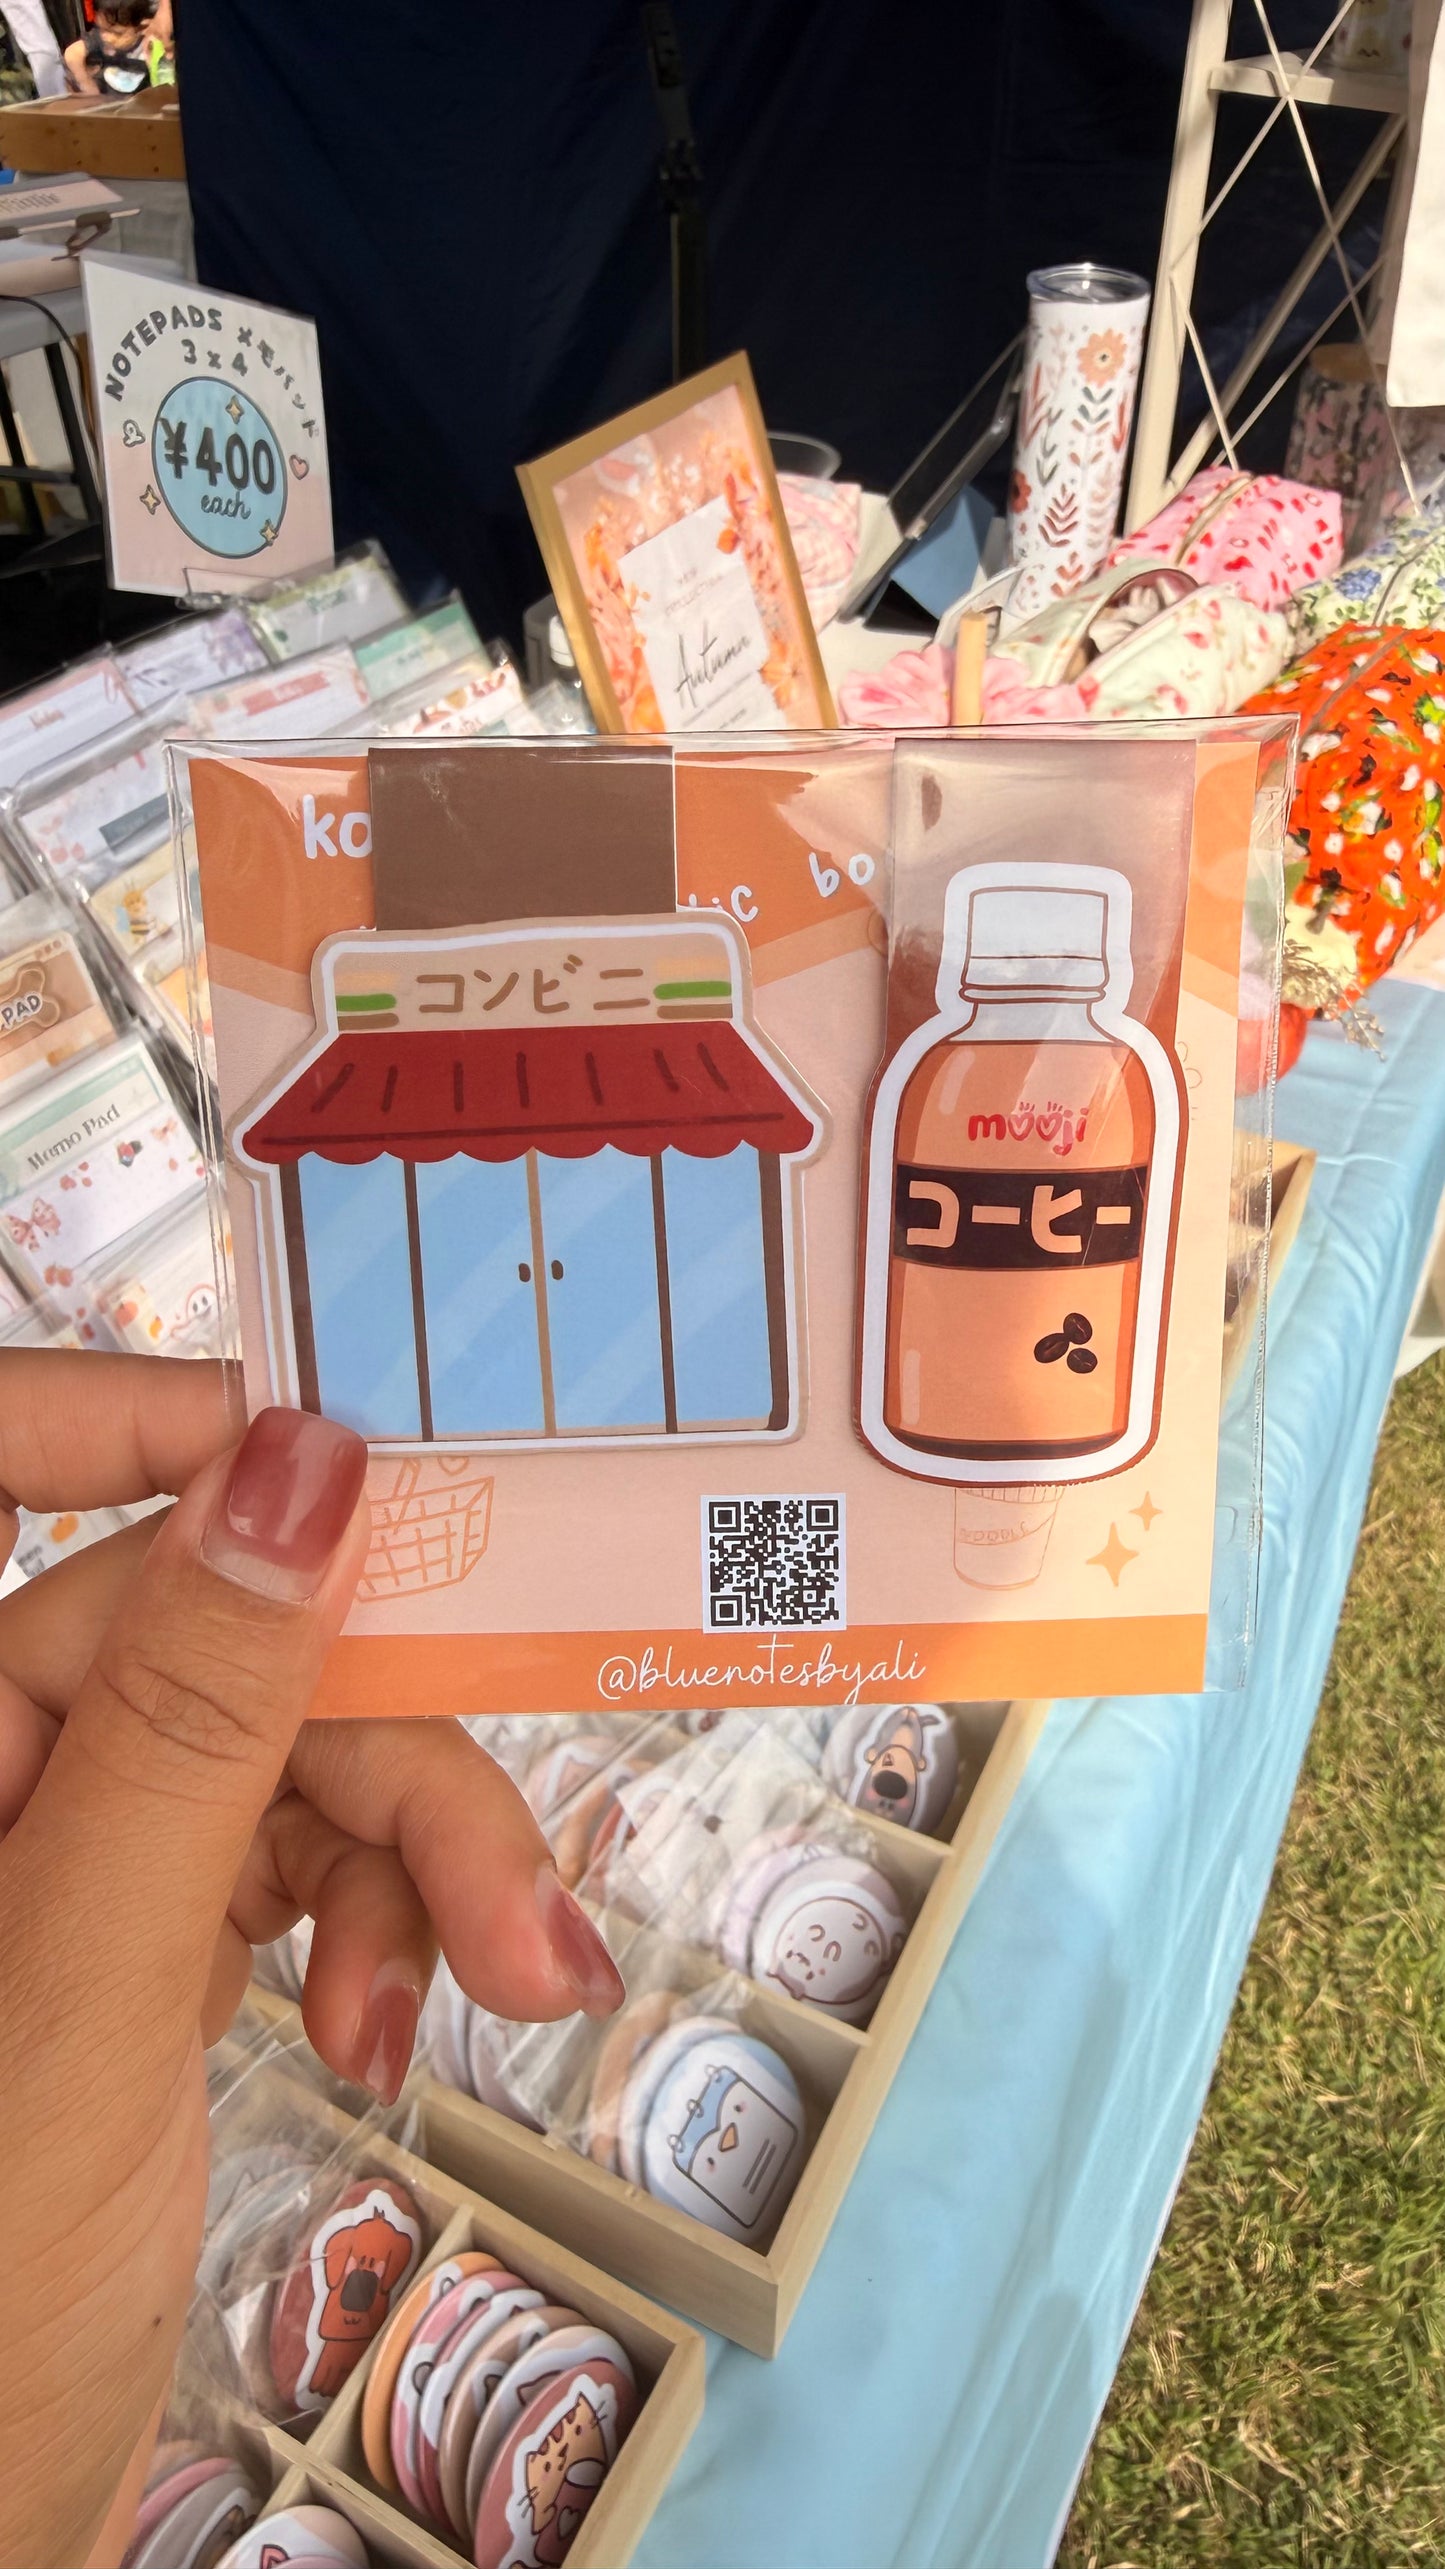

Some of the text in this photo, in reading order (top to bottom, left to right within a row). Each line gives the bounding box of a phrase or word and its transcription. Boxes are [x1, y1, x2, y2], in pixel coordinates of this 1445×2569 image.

[105, 305, 223, 401] NOTEPADS
[181, 339, 197, 364] 3
[232, 352, 248, 376] 4
[158, 418, 275, 494] ¥400
[201, 492, 251, 519] each
[674, 619, 751, 709] Autumn
[1, 994, 41, 1025] PAD
[416, 954, 650, 1013] コンビニ
[81, 1103, 121, 1137] Pad
[906, 1181, 1132, 1253] コーヒー
[597, 1634, 926, 1705] @bluenotesbyali
